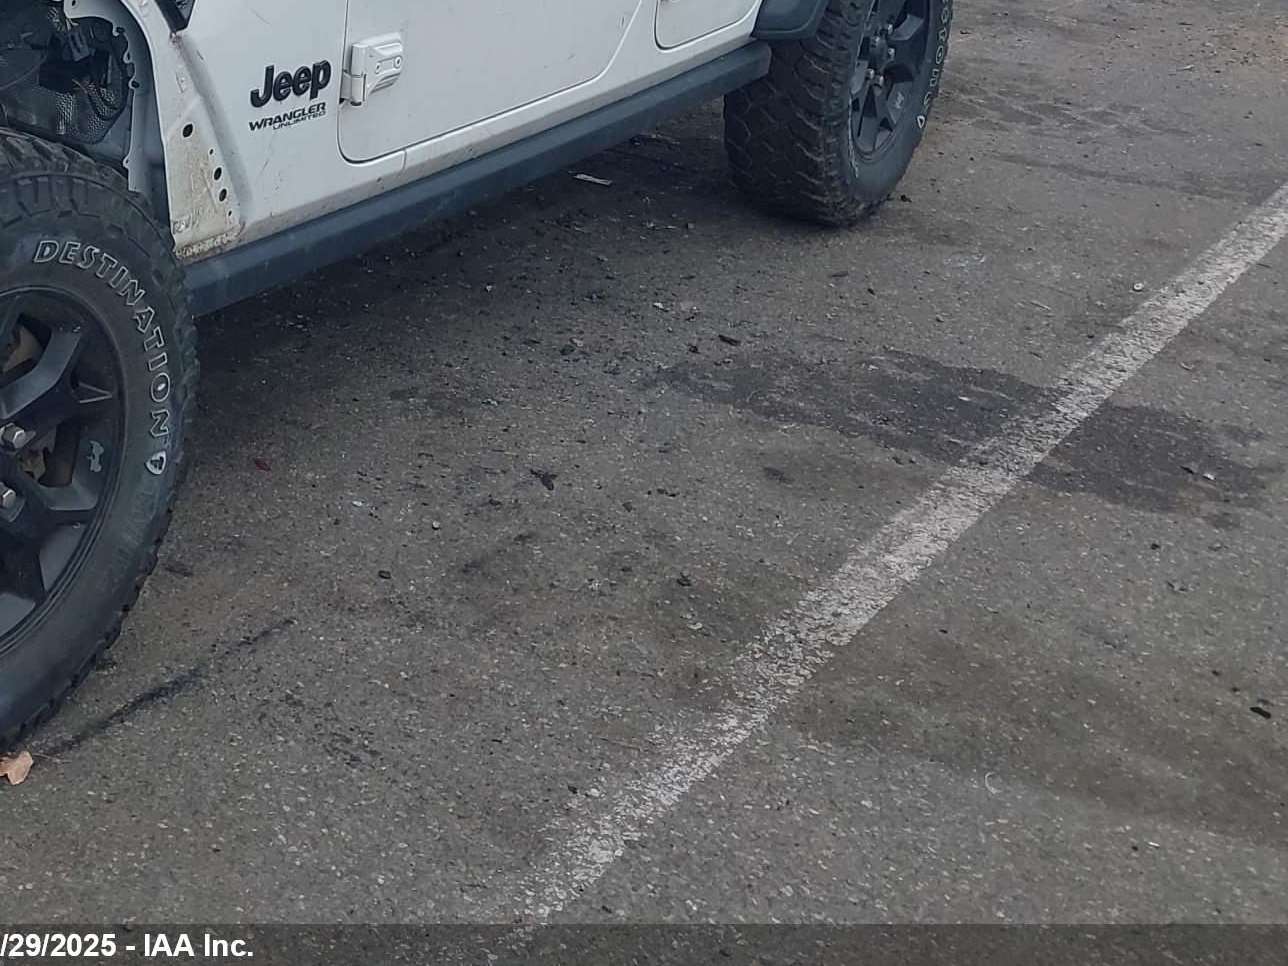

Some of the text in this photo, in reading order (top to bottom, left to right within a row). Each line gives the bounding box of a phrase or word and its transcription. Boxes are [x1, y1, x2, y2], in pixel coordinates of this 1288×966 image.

[250, 59, 332, 108] Jeep
[249, 101, 327, 132] WRANGLER
[272, 110, 327, 131] UNLIMITED
[33, 239, 171, 438] DESTINATION
